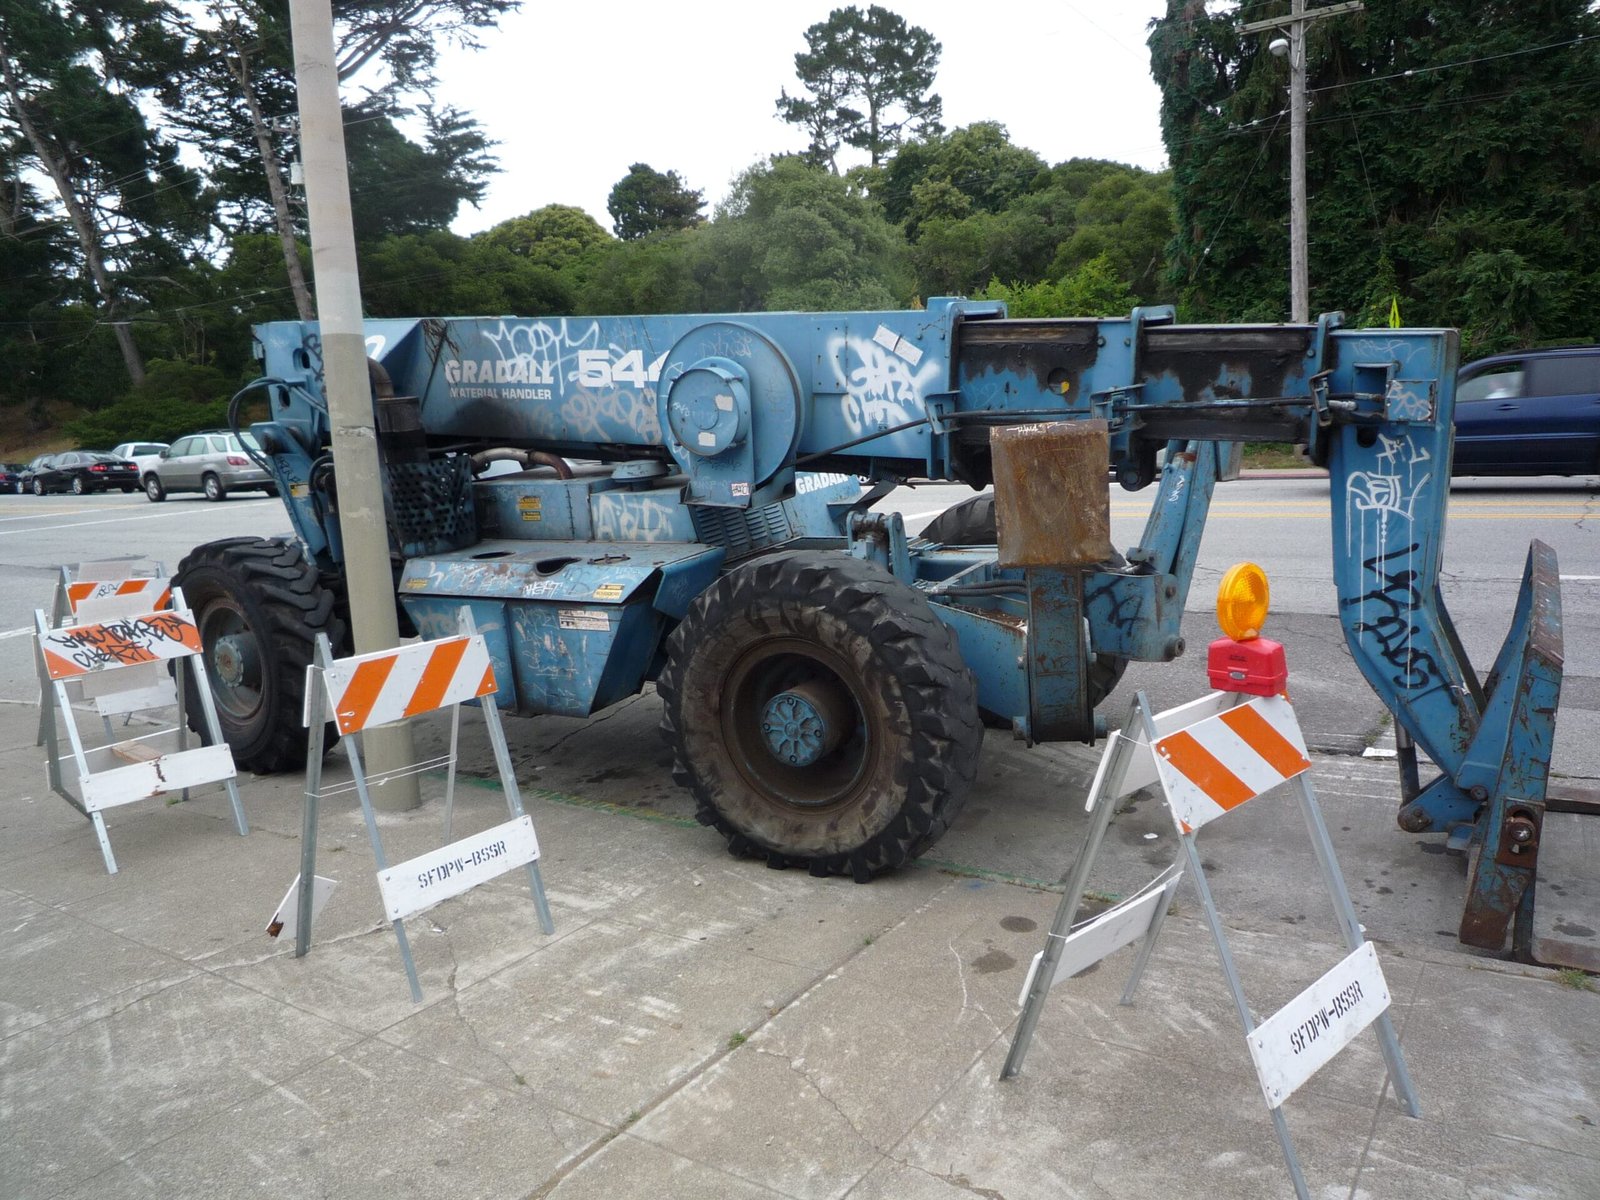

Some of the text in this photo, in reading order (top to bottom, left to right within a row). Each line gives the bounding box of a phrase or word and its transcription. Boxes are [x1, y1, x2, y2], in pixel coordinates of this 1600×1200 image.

[445, 359, 554, 385] GRADALL
[450, 387, 552, 400] MATERIAL HANDLER
[418, 840, 507, 888] SFDPW-BSSR
[1290, 980, 1364, 1055] SFDPW-BSSR
